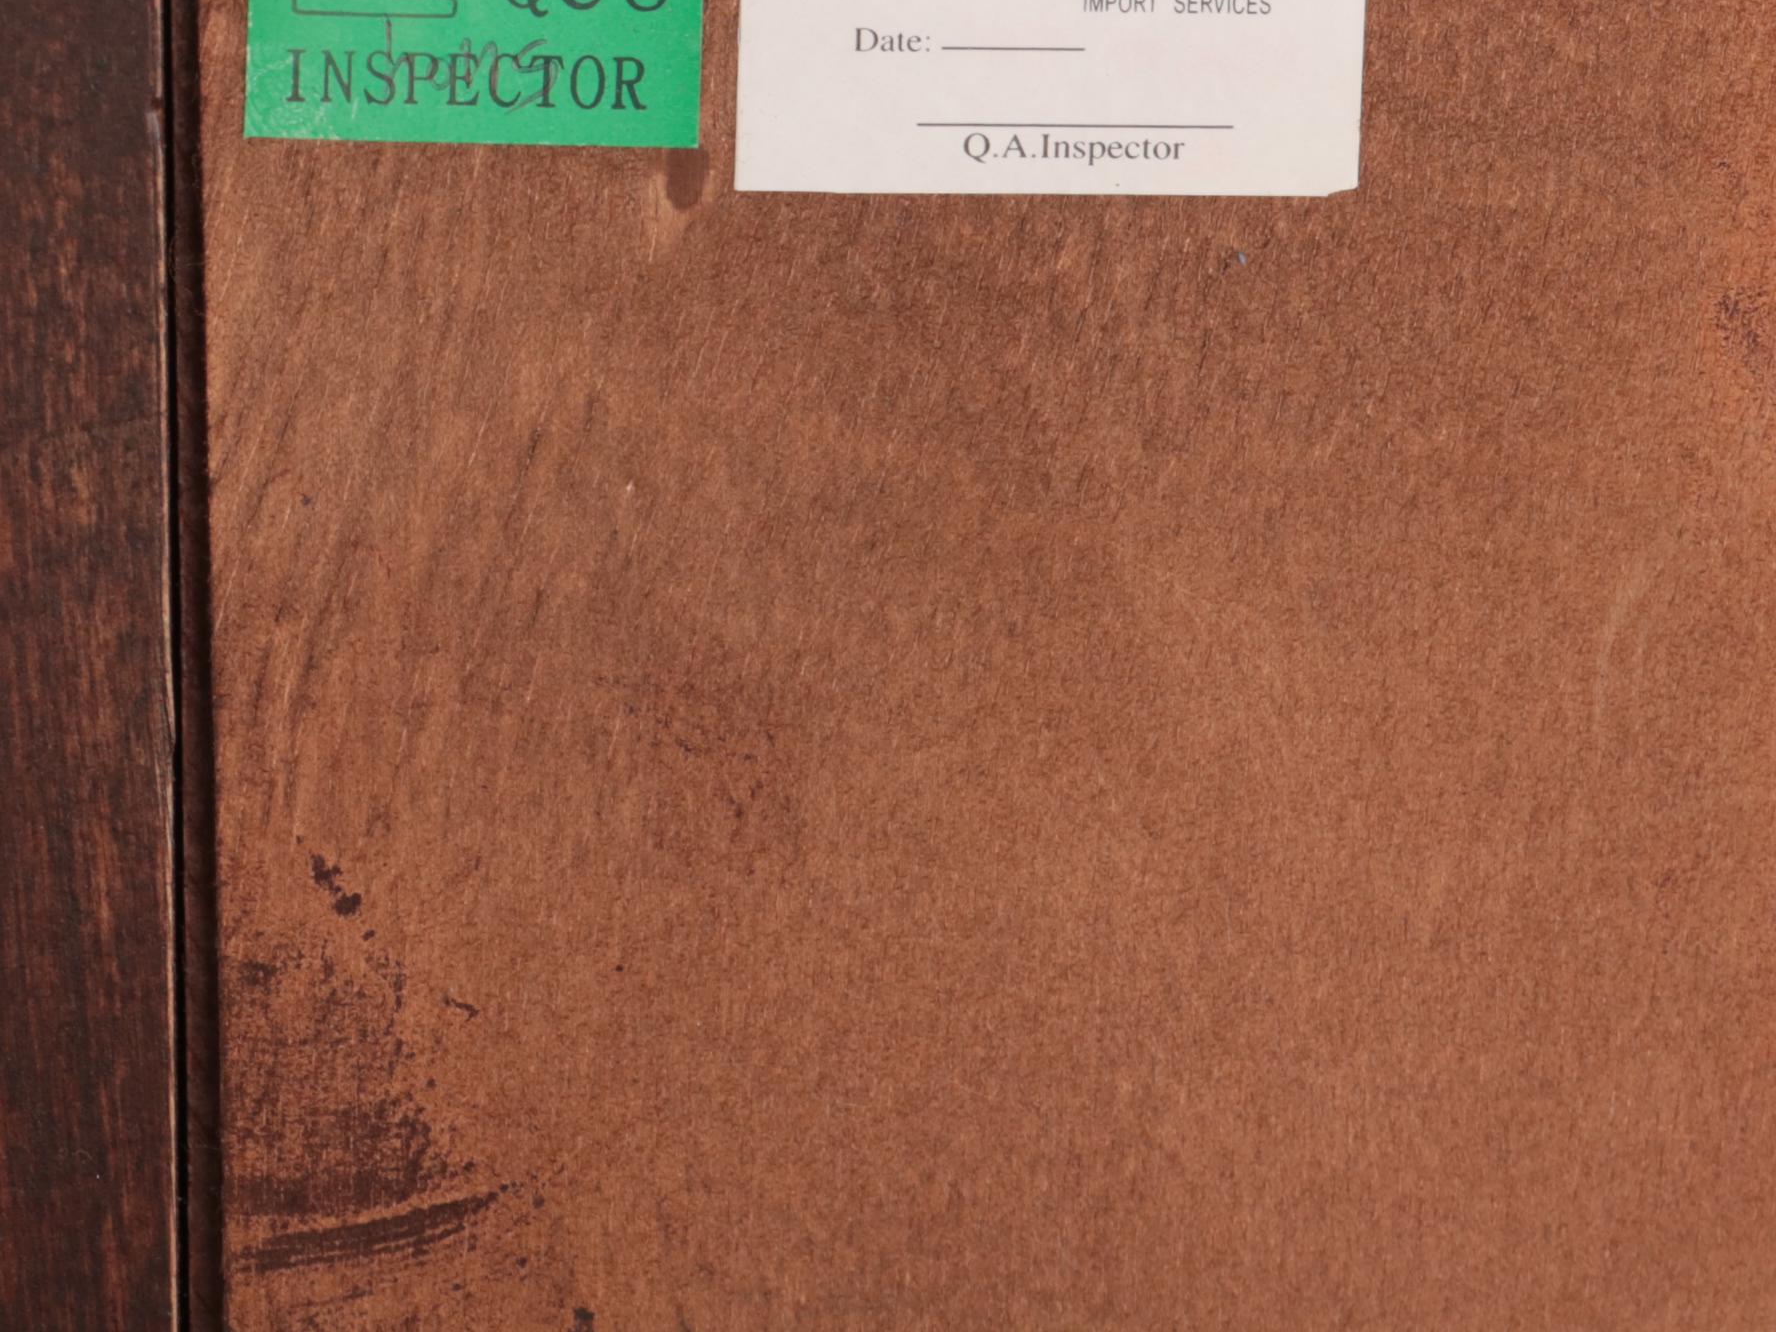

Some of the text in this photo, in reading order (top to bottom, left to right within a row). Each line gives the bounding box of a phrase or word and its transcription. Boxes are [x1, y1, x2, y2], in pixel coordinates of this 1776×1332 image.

[854, 27, 932, 54] Date:
[285, 48, 648, 111] INSPECTOR
[962, 131, 1186, 166] Q.A.Inspector
